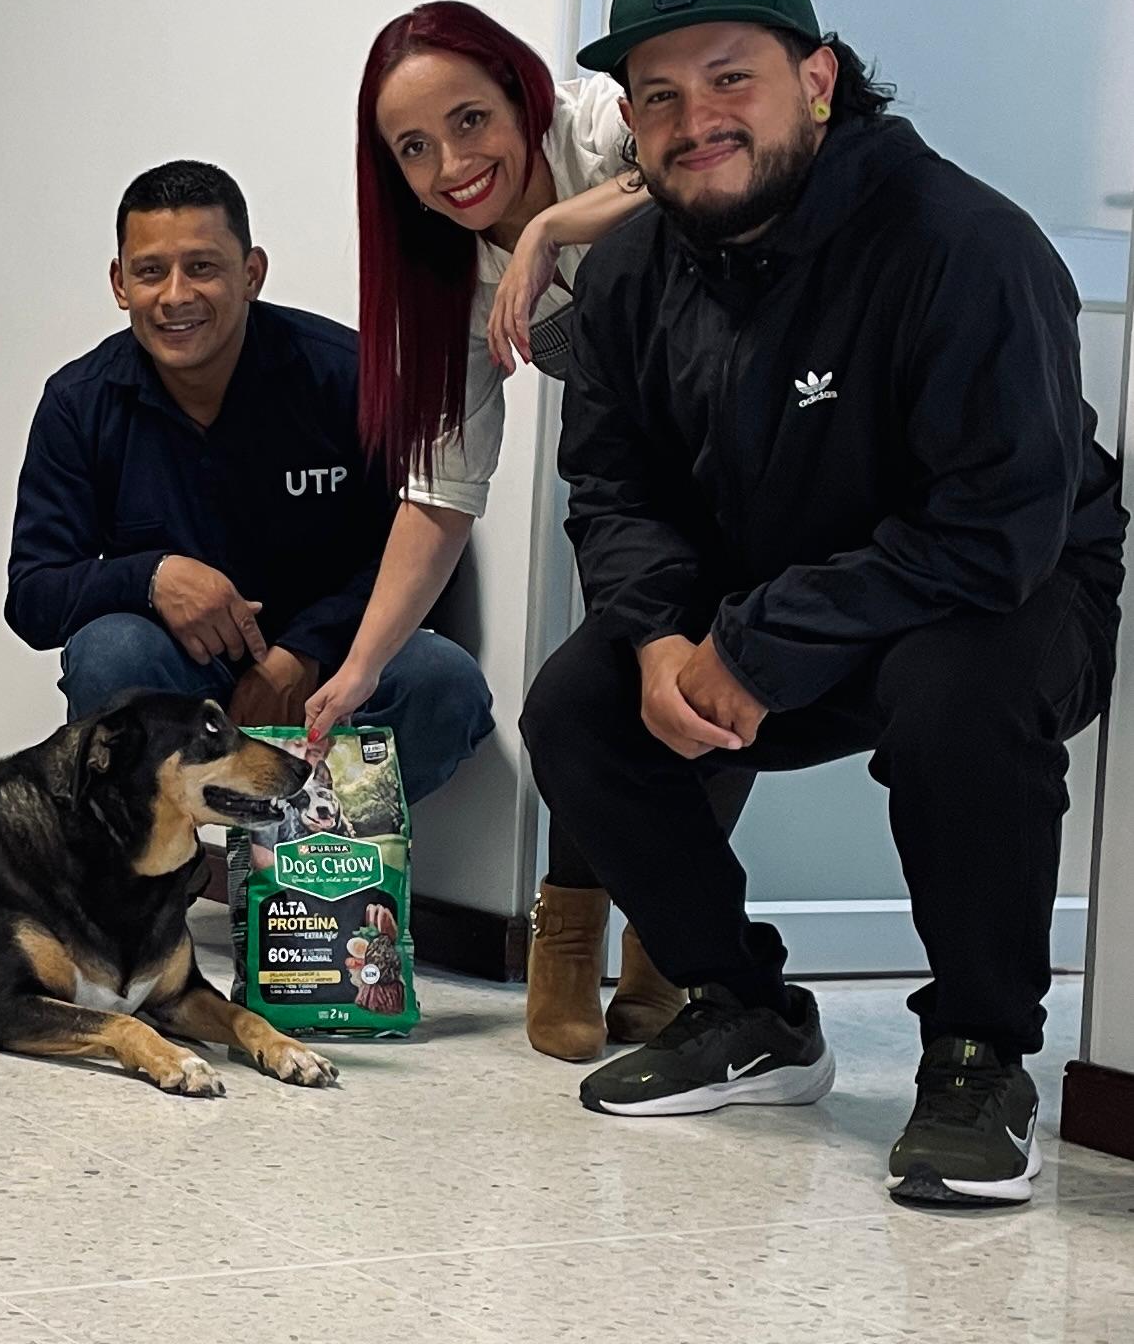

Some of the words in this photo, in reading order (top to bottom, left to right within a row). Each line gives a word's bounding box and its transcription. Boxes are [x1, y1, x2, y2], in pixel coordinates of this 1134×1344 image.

[799, 391, 837, 407] adidas
[286, 466, 347, 496] UTP
[310, 845, 349, 853] PURINA
[281, 855, 317, 874] DOG
[322, 856, 373, 874] CHOW
[268, 901, 308, 916] ALTA
[268, 913, 338, 931] PROTEÍNA
[268, 947, 301, 963] 60%
[330, 1008, 337, 1019] 2
[338, 1011, 349, 1021] kg
